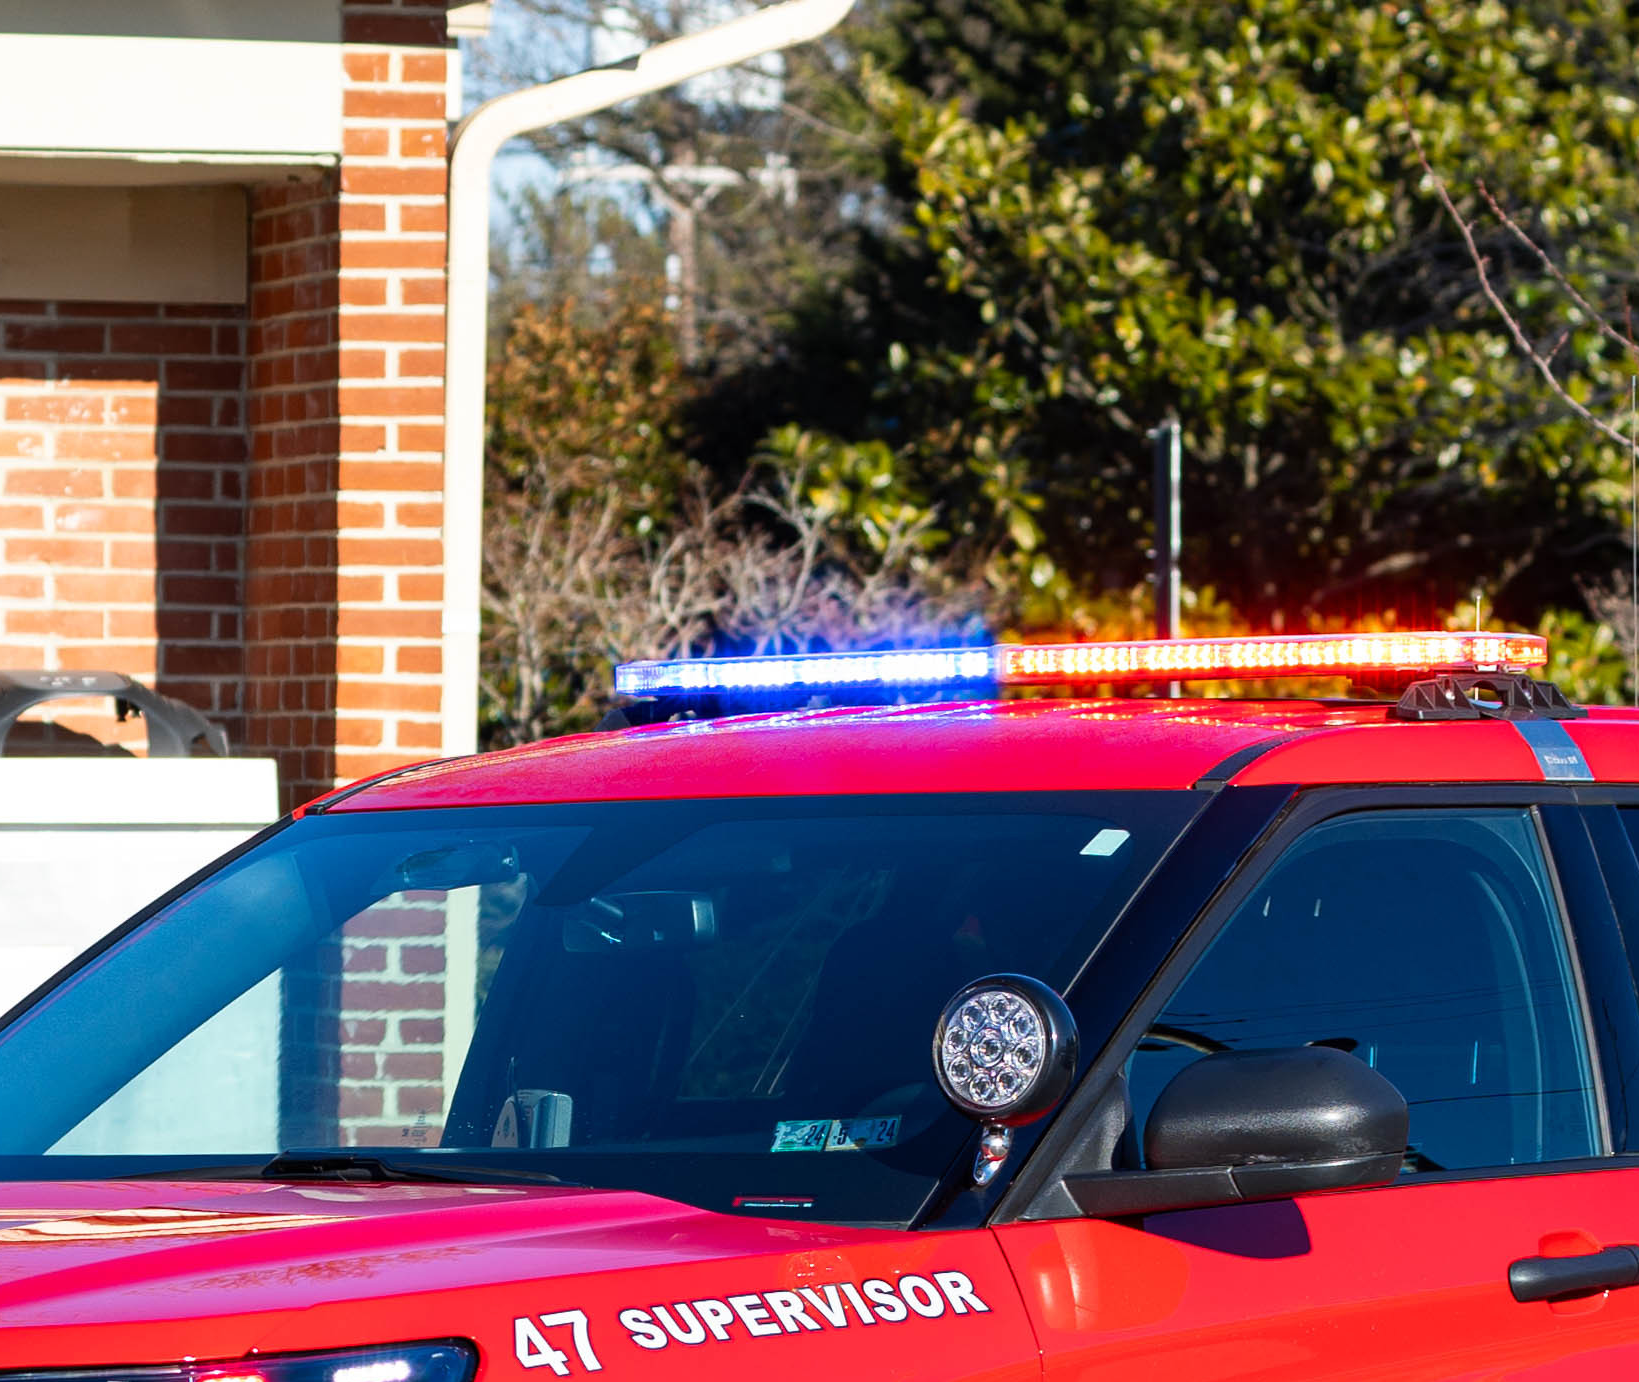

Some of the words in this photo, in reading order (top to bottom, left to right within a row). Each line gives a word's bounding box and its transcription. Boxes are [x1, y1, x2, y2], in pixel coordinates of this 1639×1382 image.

[805, 1124, 826, 1146] 24
[876, 1119, 897, 1142] 24
[515, 1309, 602, 1376] 47
[619, 1271, 990, 1350] SUPERVISOR
